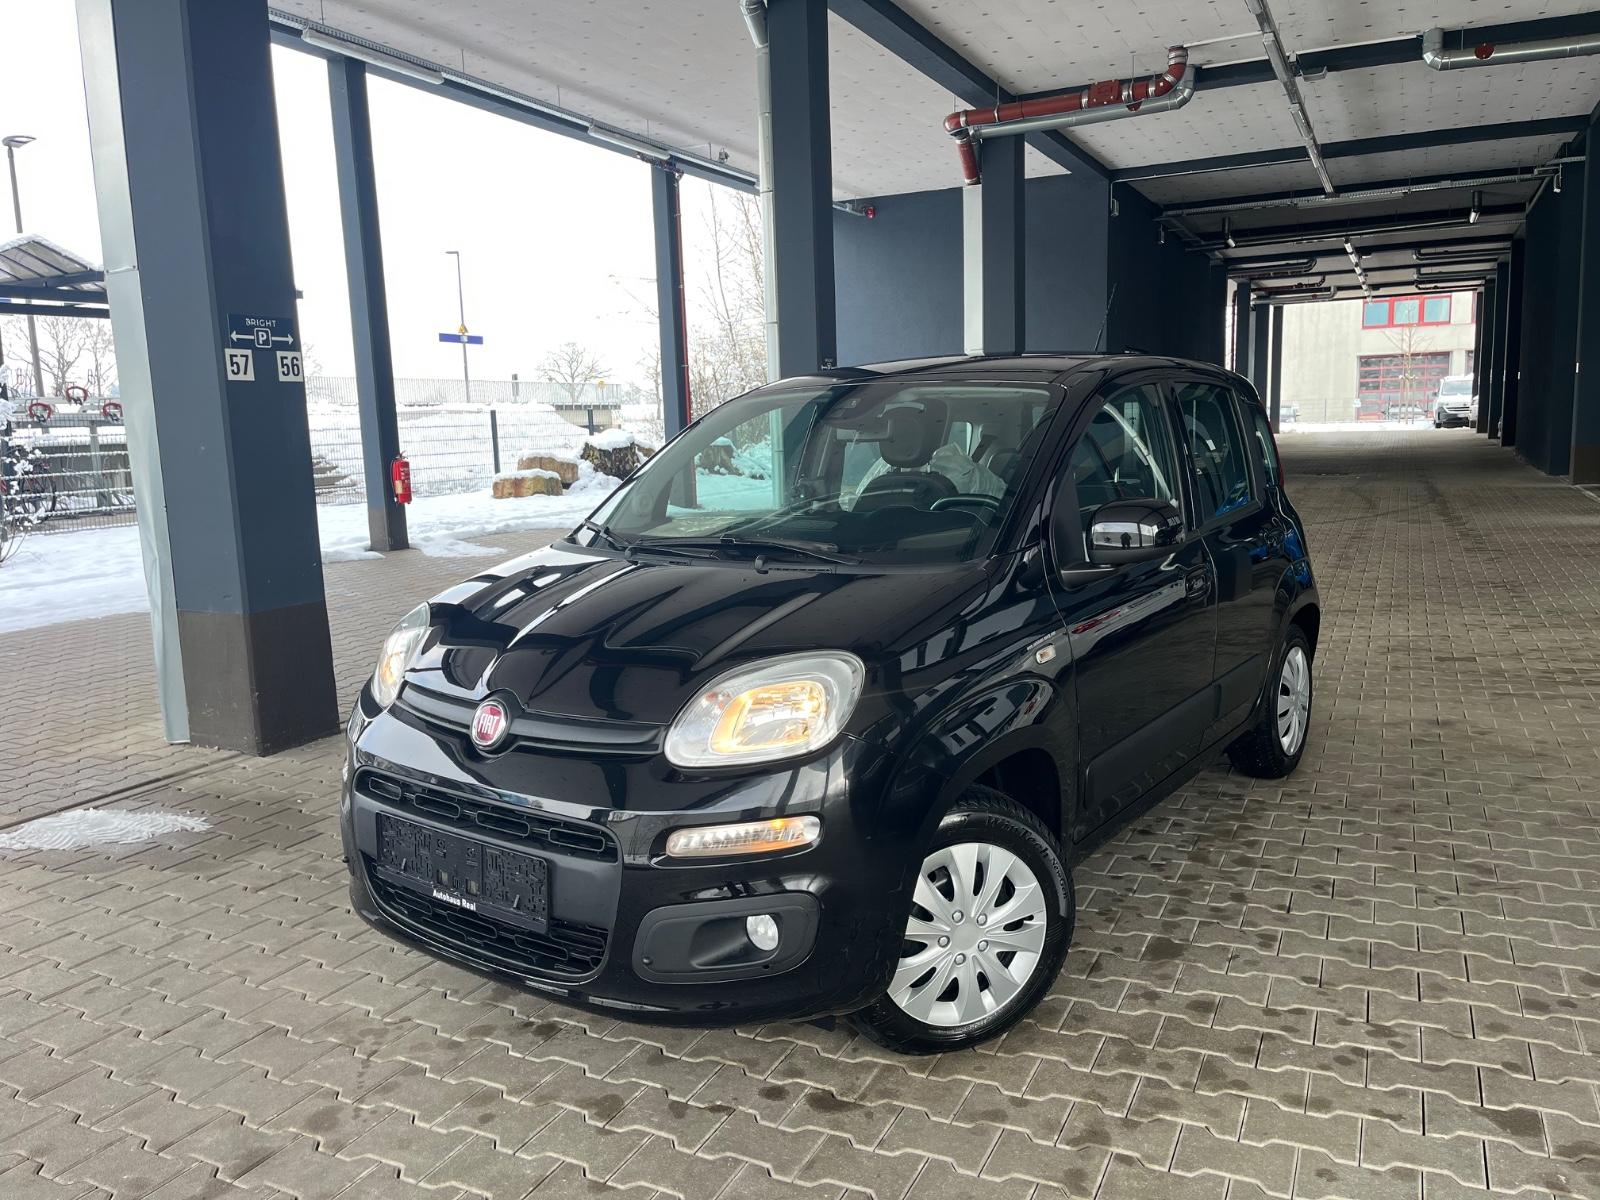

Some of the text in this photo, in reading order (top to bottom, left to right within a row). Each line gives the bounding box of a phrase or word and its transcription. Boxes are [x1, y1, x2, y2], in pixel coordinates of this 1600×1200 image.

[245, 318, 276, 328] BRIGHT
[258, 331, 267, 344] P
[229, 354, 249, 375] 57
[280, 355, 300, 377] 56
[477, 713, 500, 735] FIAT
[432, 889, 477, 911] Autohaus Real
